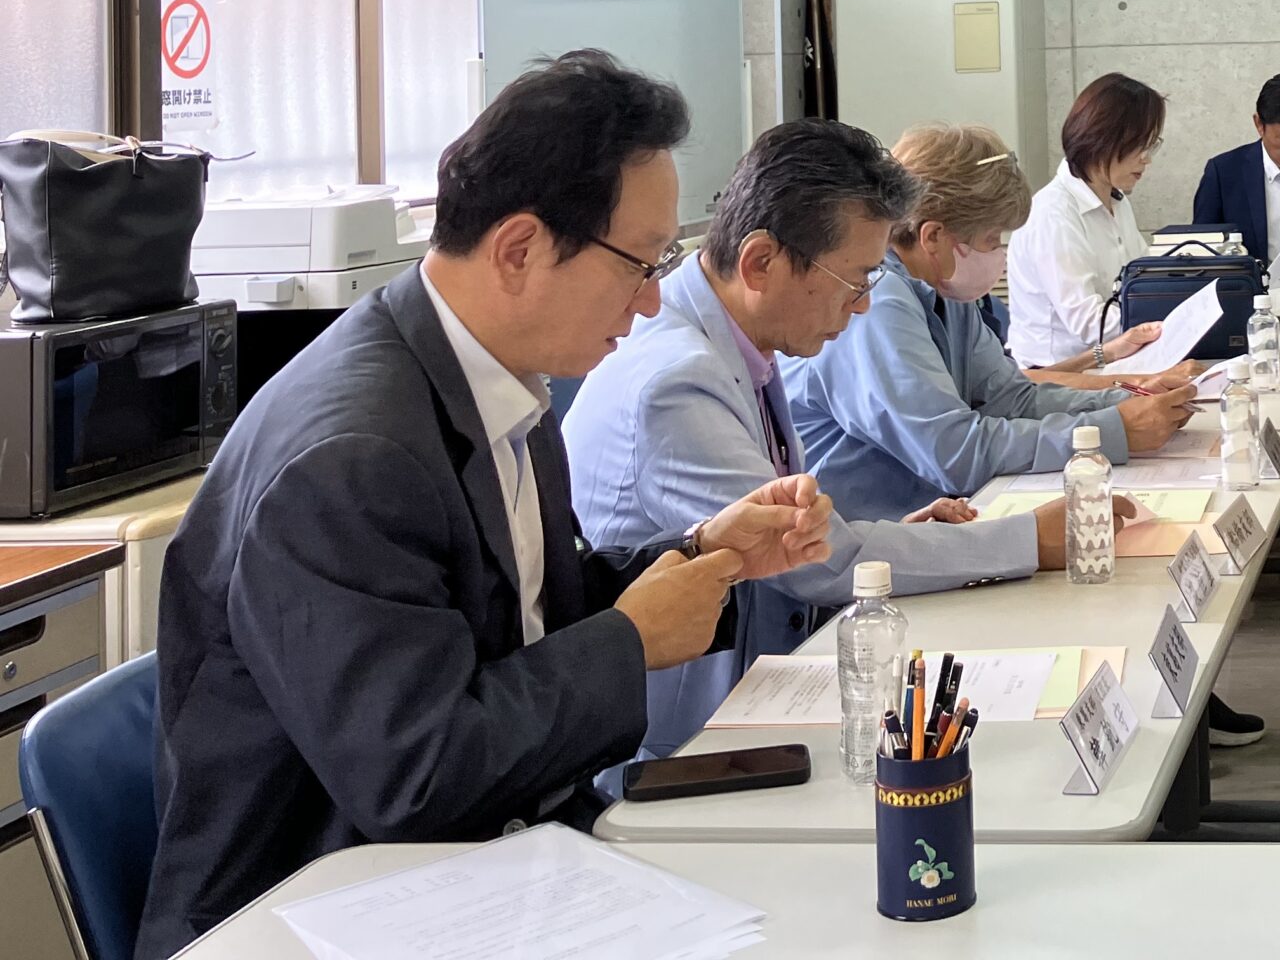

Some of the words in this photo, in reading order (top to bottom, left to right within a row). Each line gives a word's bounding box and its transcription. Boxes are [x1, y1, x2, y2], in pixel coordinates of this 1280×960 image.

[162, 88, 212, 106] 窓開け禁止
